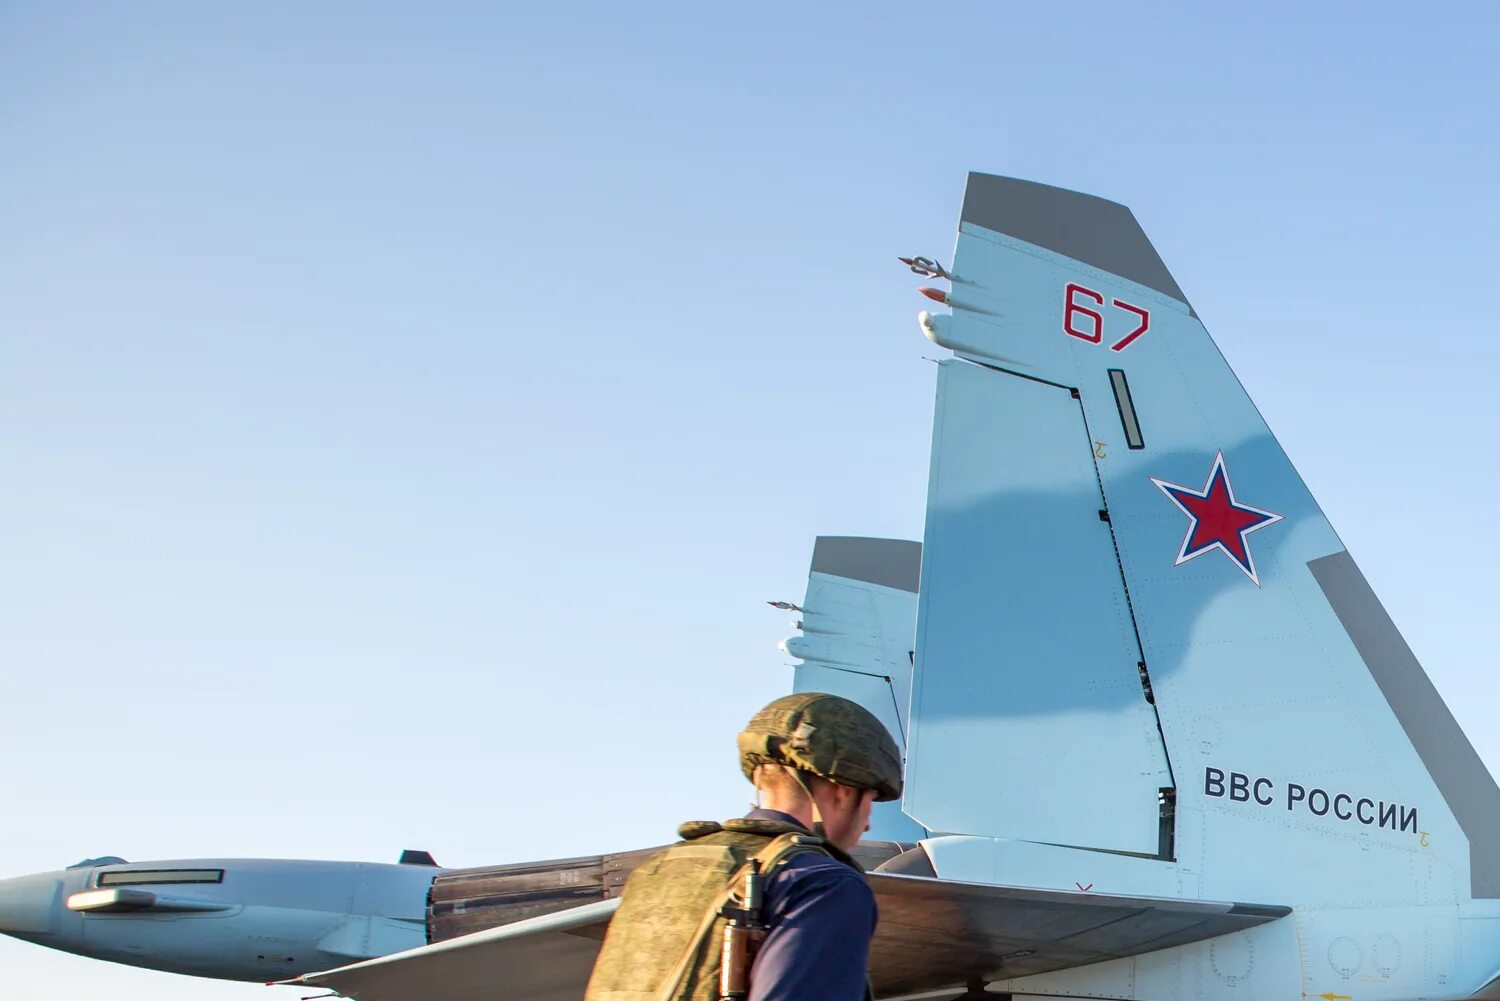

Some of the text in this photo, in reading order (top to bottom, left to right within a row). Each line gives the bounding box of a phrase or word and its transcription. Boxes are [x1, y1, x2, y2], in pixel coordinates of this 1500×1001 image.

[1063, 282, 1150, 352] 67
[1204, 766, 1418, 835] ВВС РОССИИ
